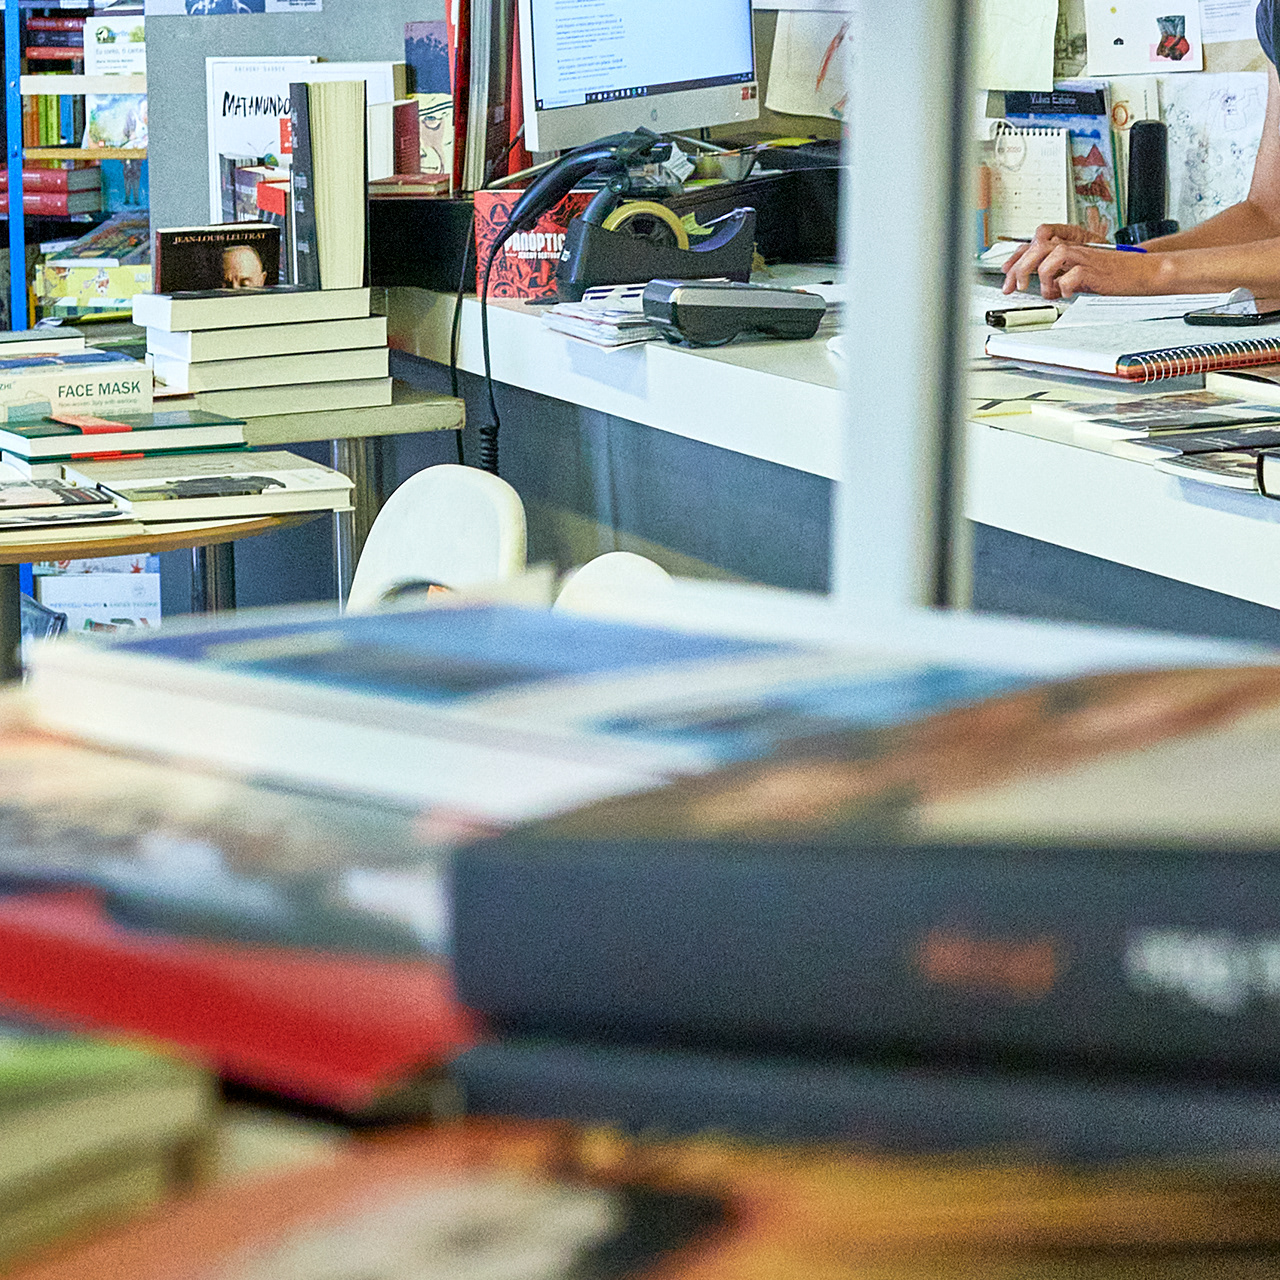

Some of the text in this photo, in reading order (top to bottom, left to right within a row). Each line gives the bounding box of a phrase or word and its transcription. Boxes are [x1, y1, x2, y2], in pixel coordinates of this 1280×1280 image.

[172, 234, 225, 245] JEAN-LOUIS
[58, 383, 94, 399] FACE
[99, 380, 141, 396] MASK
